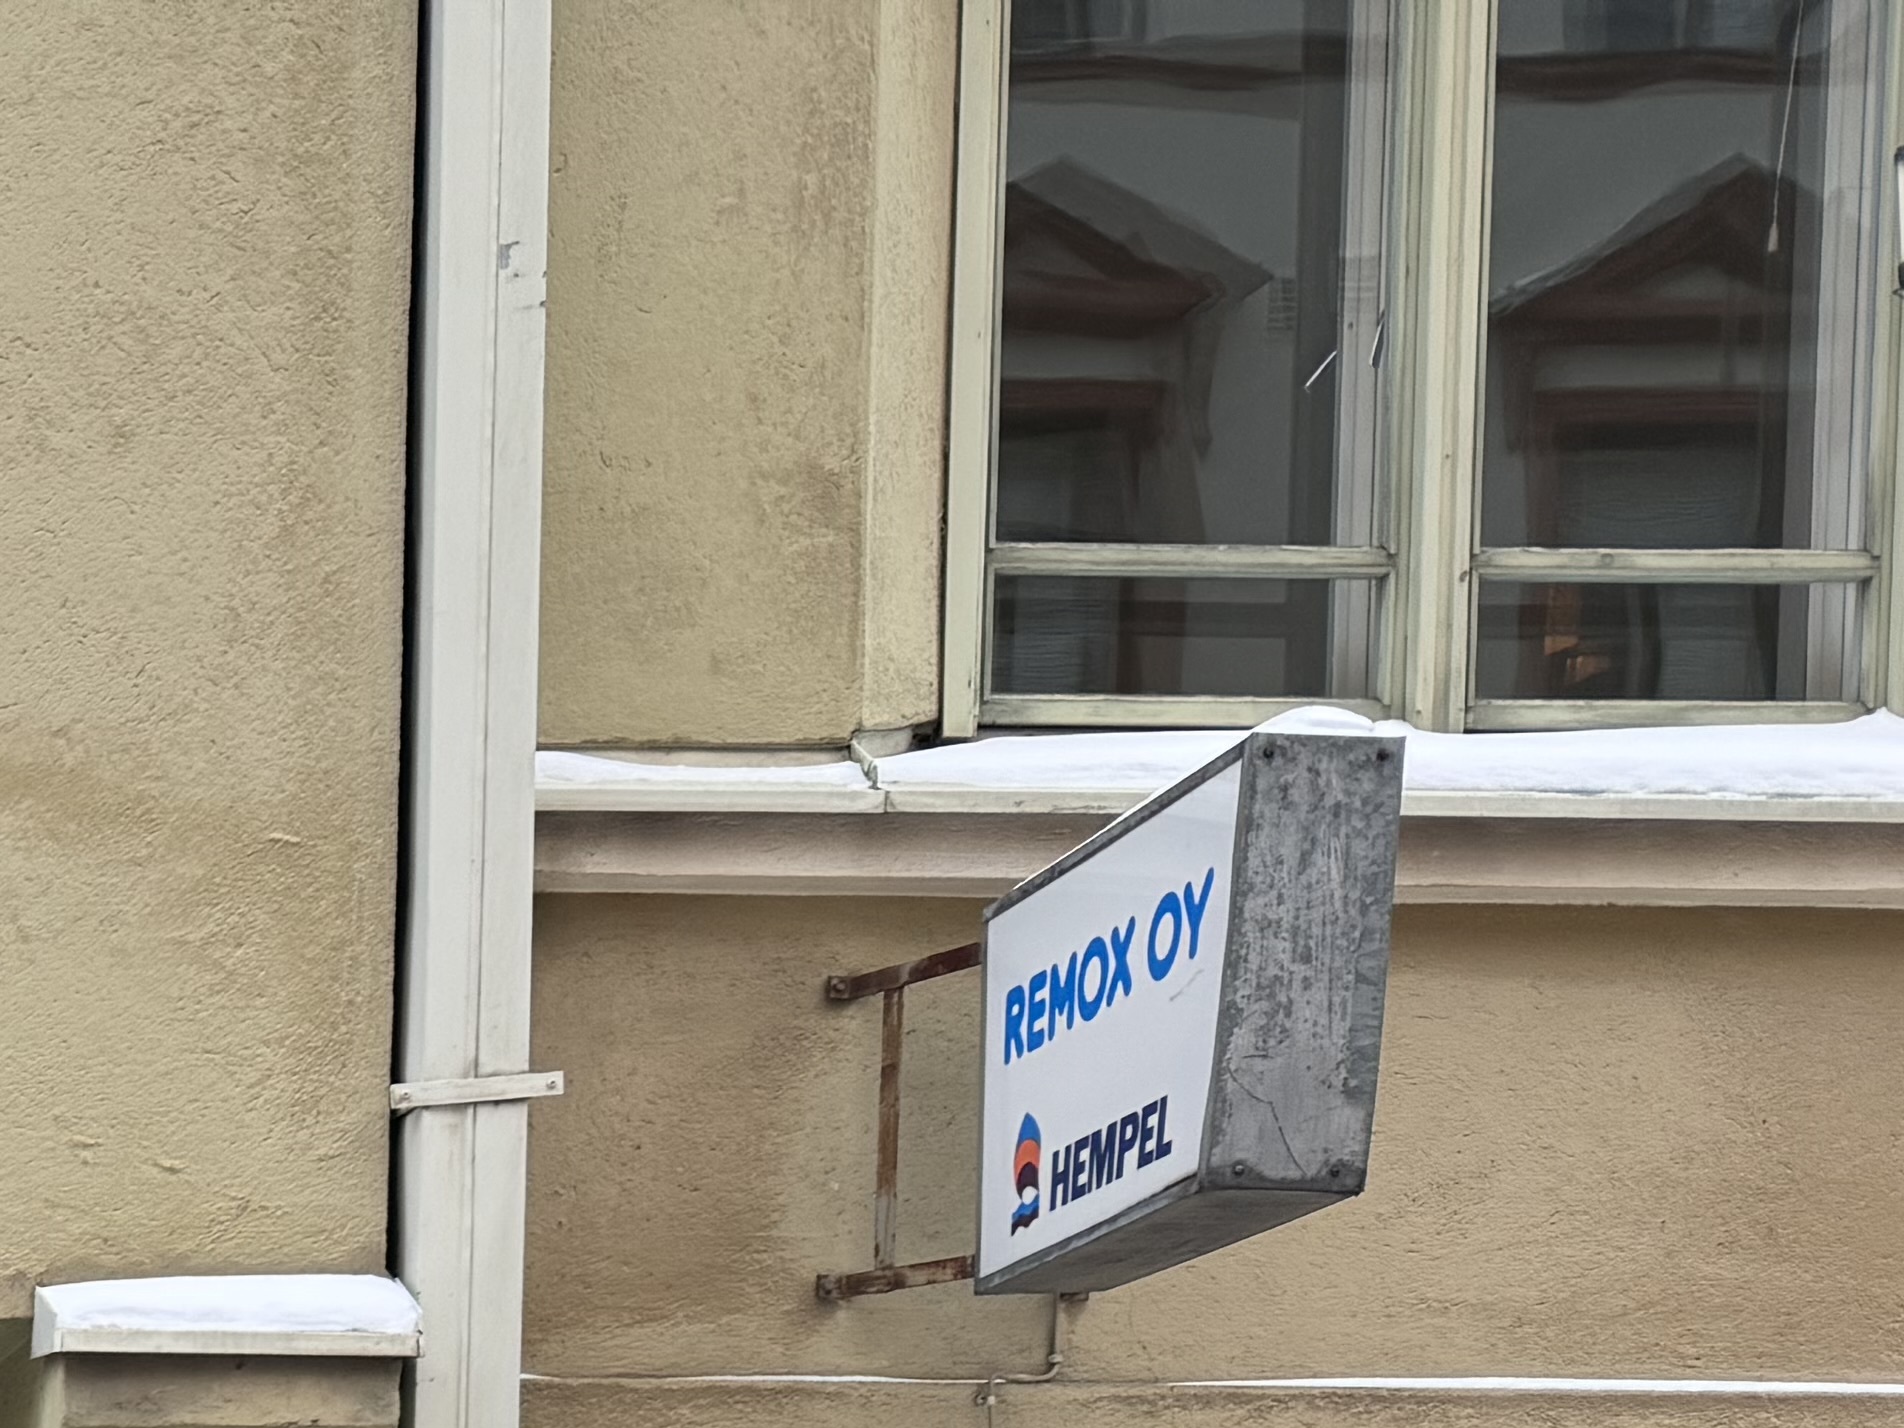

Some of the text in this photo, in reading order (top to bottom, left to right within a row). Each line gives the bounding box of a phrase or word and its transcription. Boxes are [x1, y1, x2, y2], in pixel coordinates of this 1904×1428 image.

[1003, 867, 1214, 1065] REMOX OY
[1049, 1094, 1173, 1212] HEMPEL
